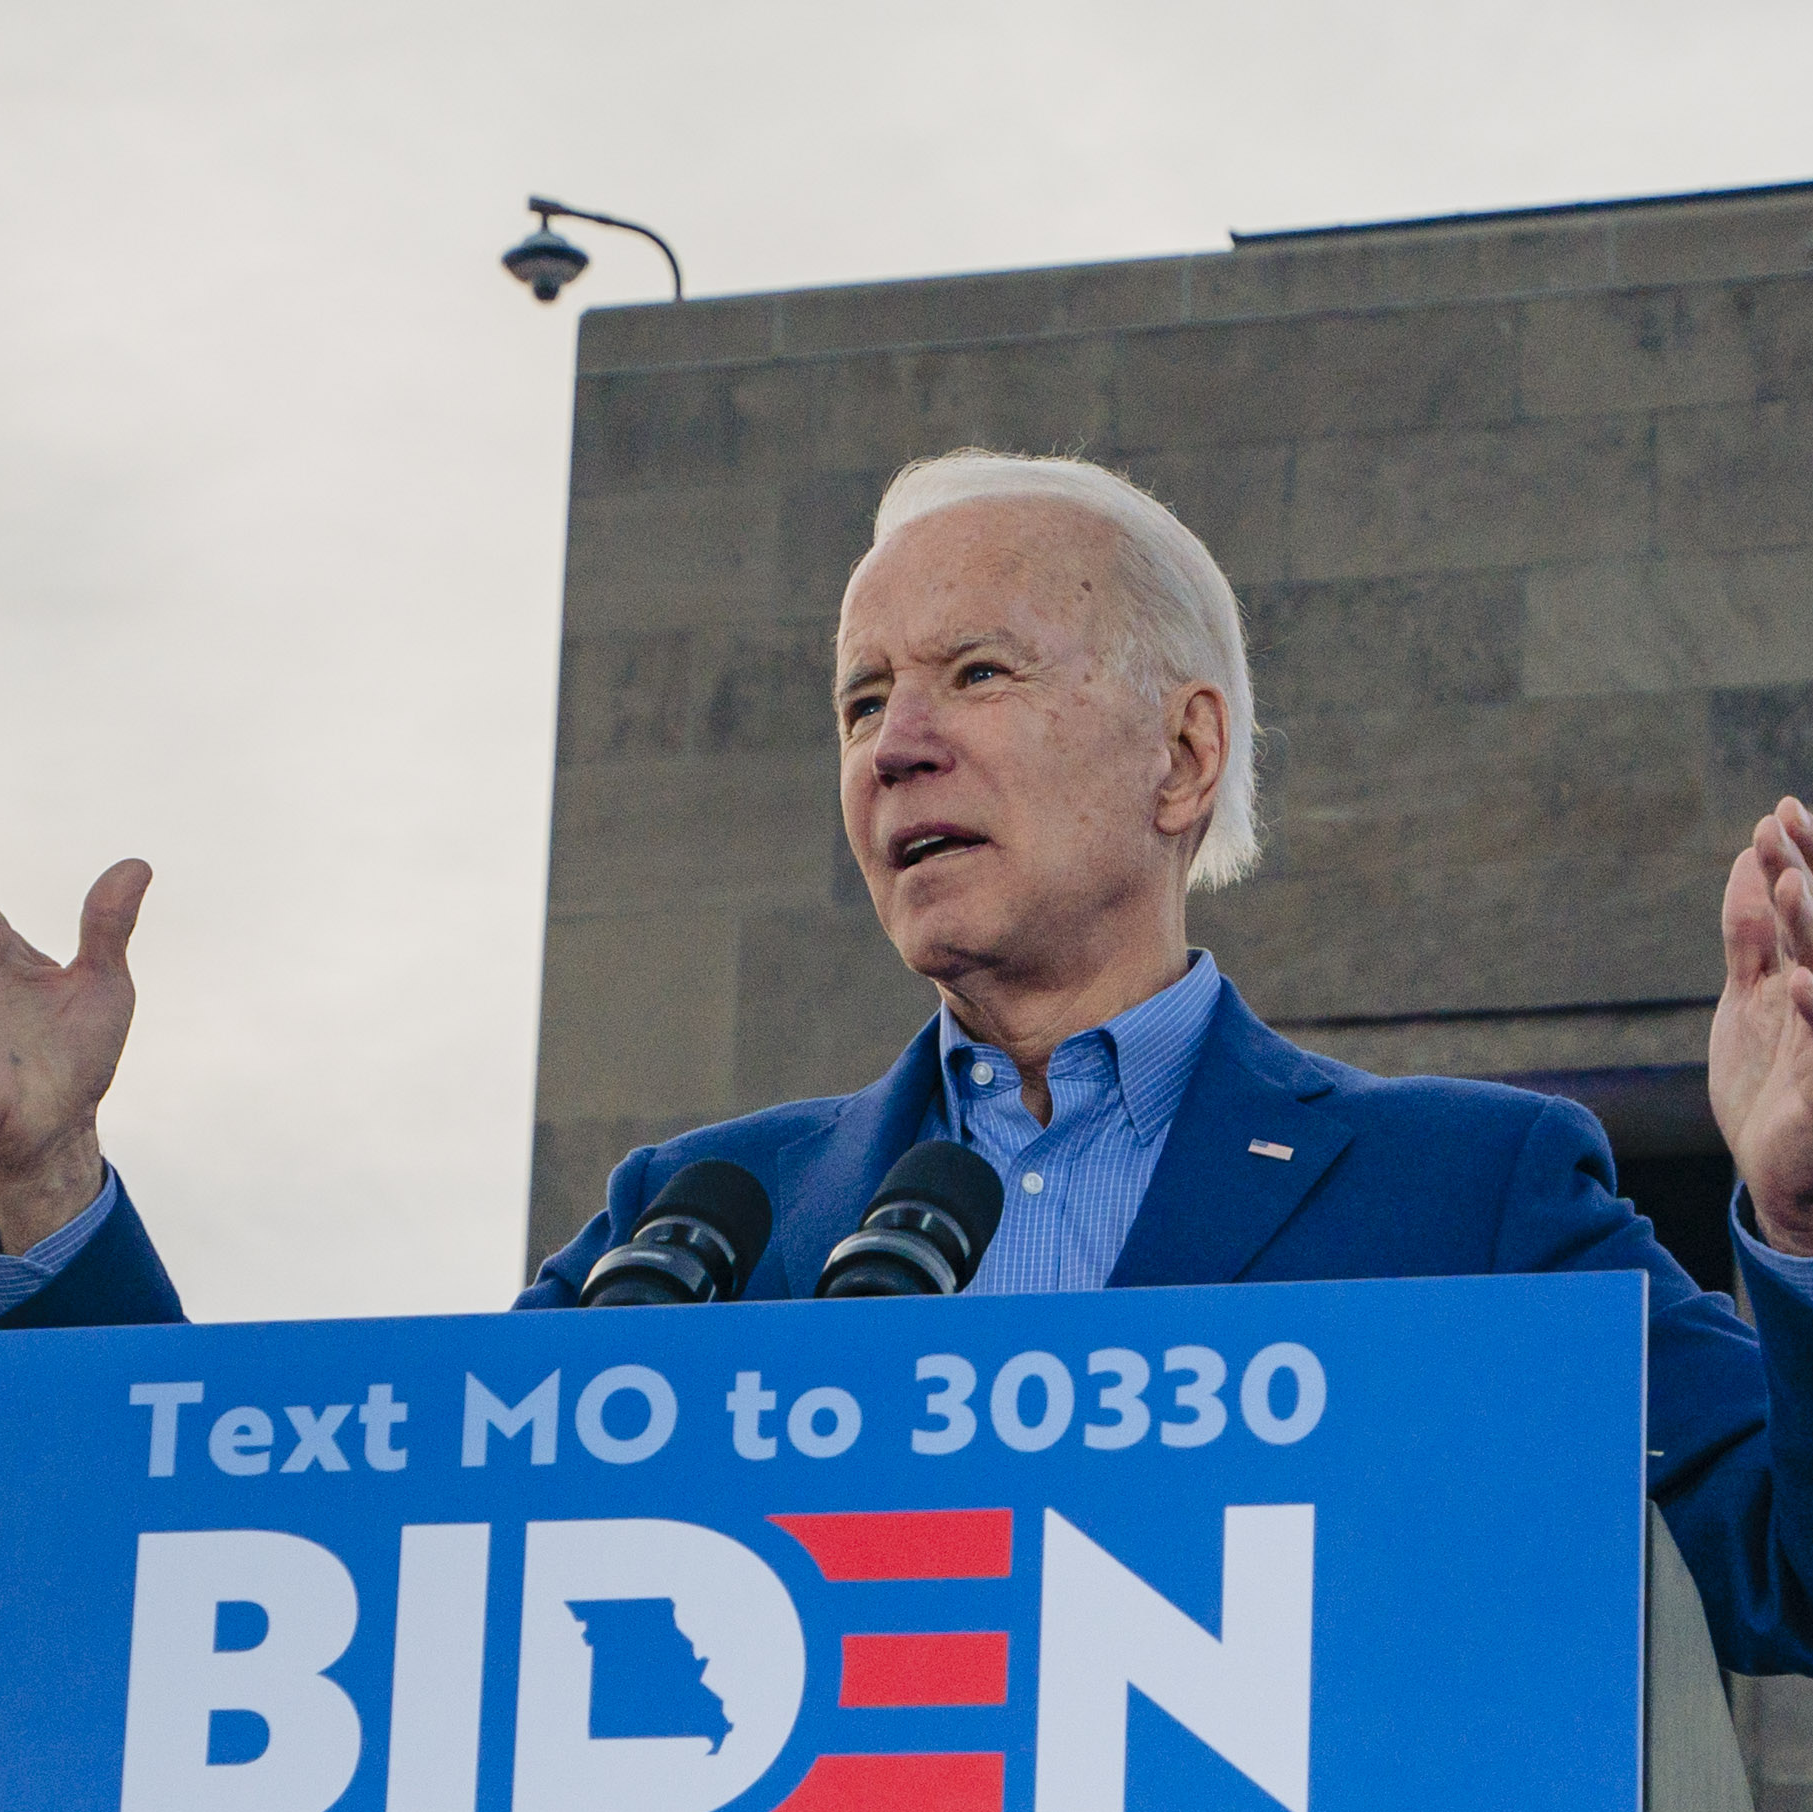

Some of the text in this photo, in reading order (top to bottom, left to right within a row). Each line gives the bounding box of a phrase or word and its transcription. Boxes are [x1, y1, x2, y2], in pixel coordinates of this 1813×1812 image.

[129, 1341, 1328, 1477] Text MO to 30330
